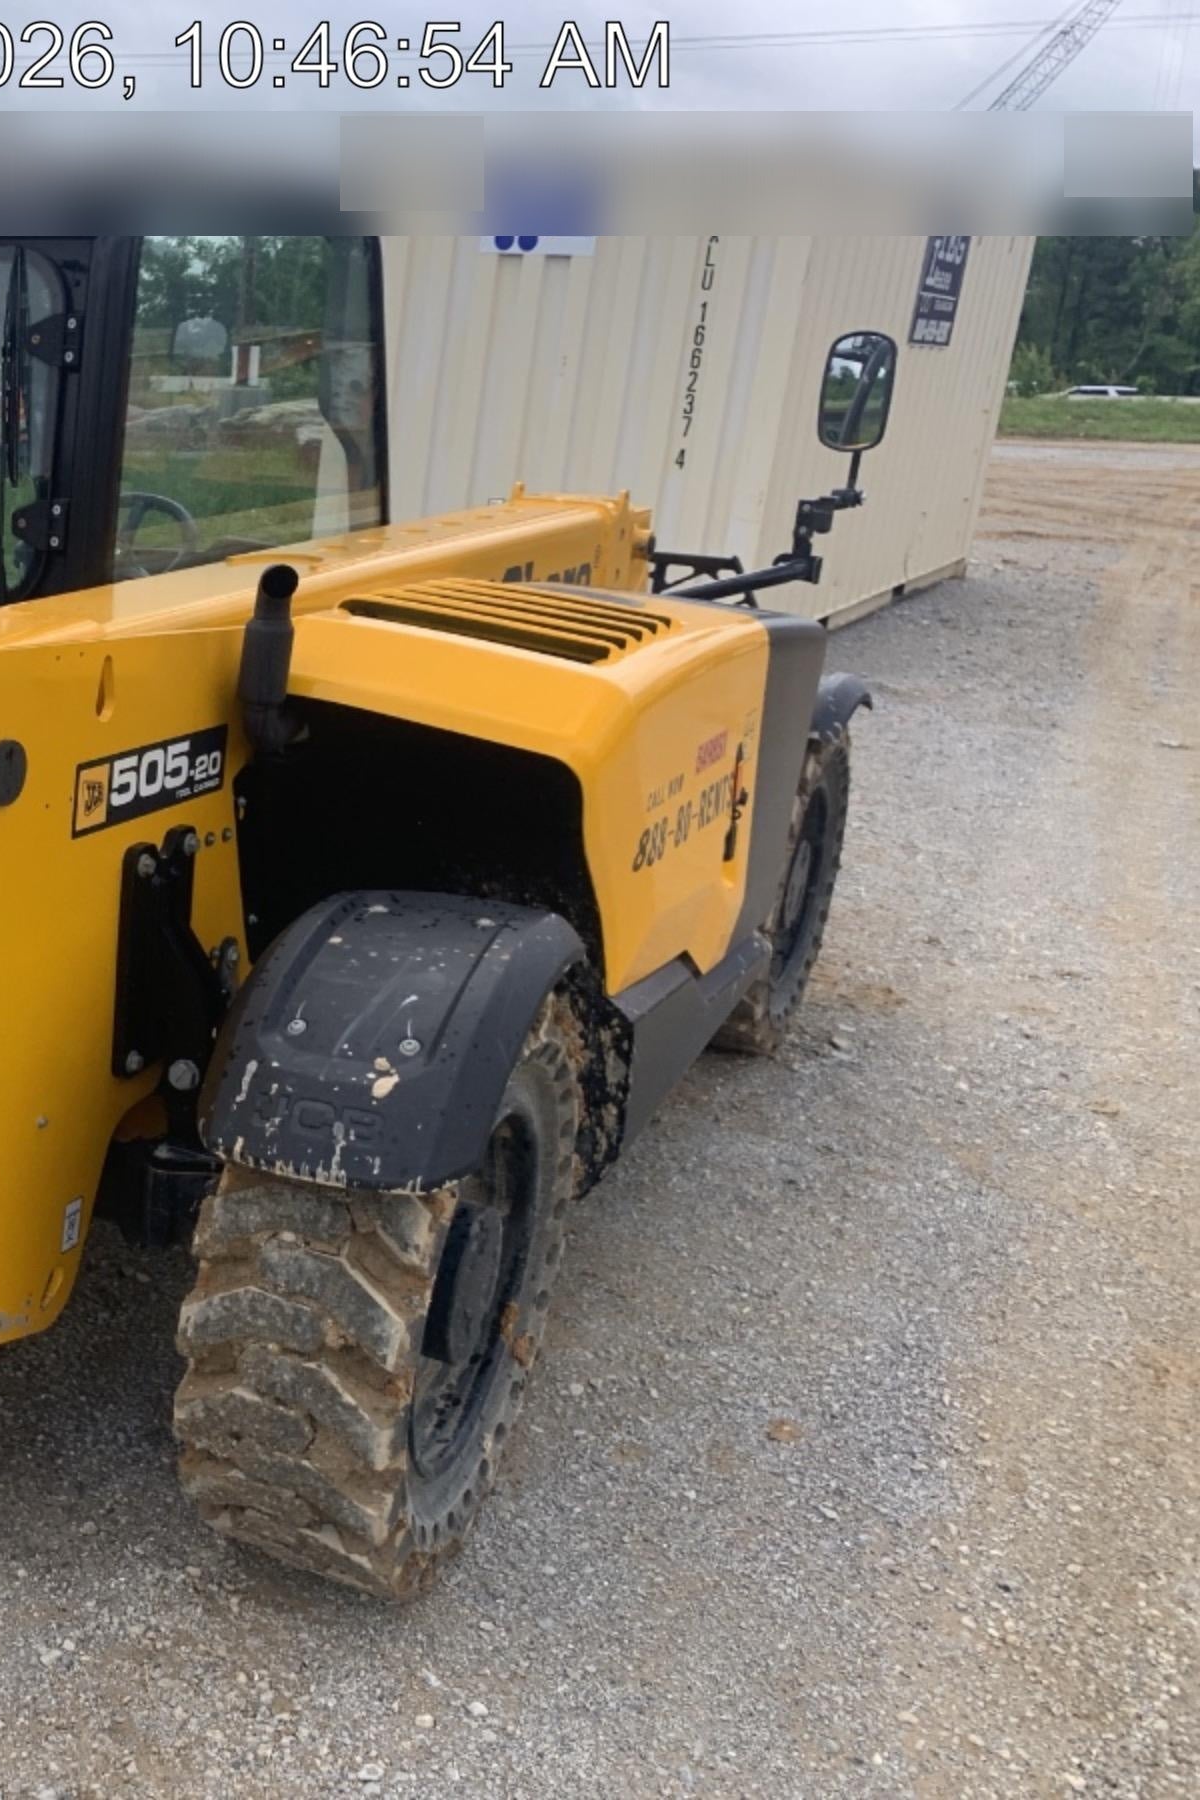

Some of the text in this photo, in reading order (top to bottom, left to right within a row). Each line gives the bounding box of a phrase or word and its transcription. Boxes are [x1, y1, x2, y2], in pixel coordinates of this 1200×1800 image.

[701, 236, 719, 290] LU
[683, 301, 707, 437] 166237
[110, 740, 222, 807] 505-20
